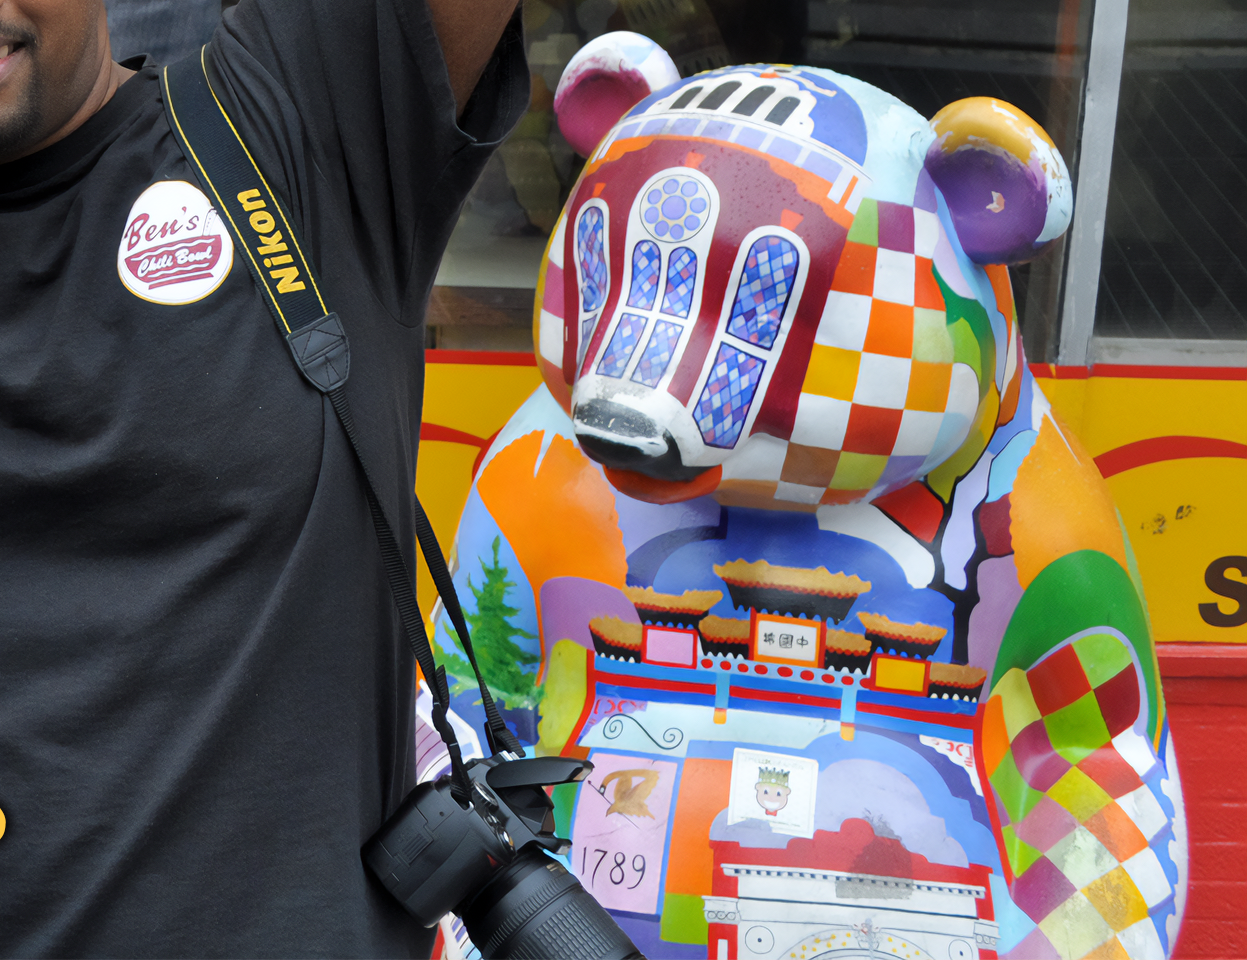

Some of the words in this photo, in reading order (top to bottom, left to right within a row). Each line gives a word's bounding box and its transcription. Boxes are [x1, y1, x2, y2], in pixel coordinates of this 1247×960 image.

[124, 206, 200, 252] Ben's
[236, 187, 306, 294] Nikon
[137, 253, 174, 276] Chili
[176, 245, 213, 265] Bowl
[581, 845, 647, 890] 1789
